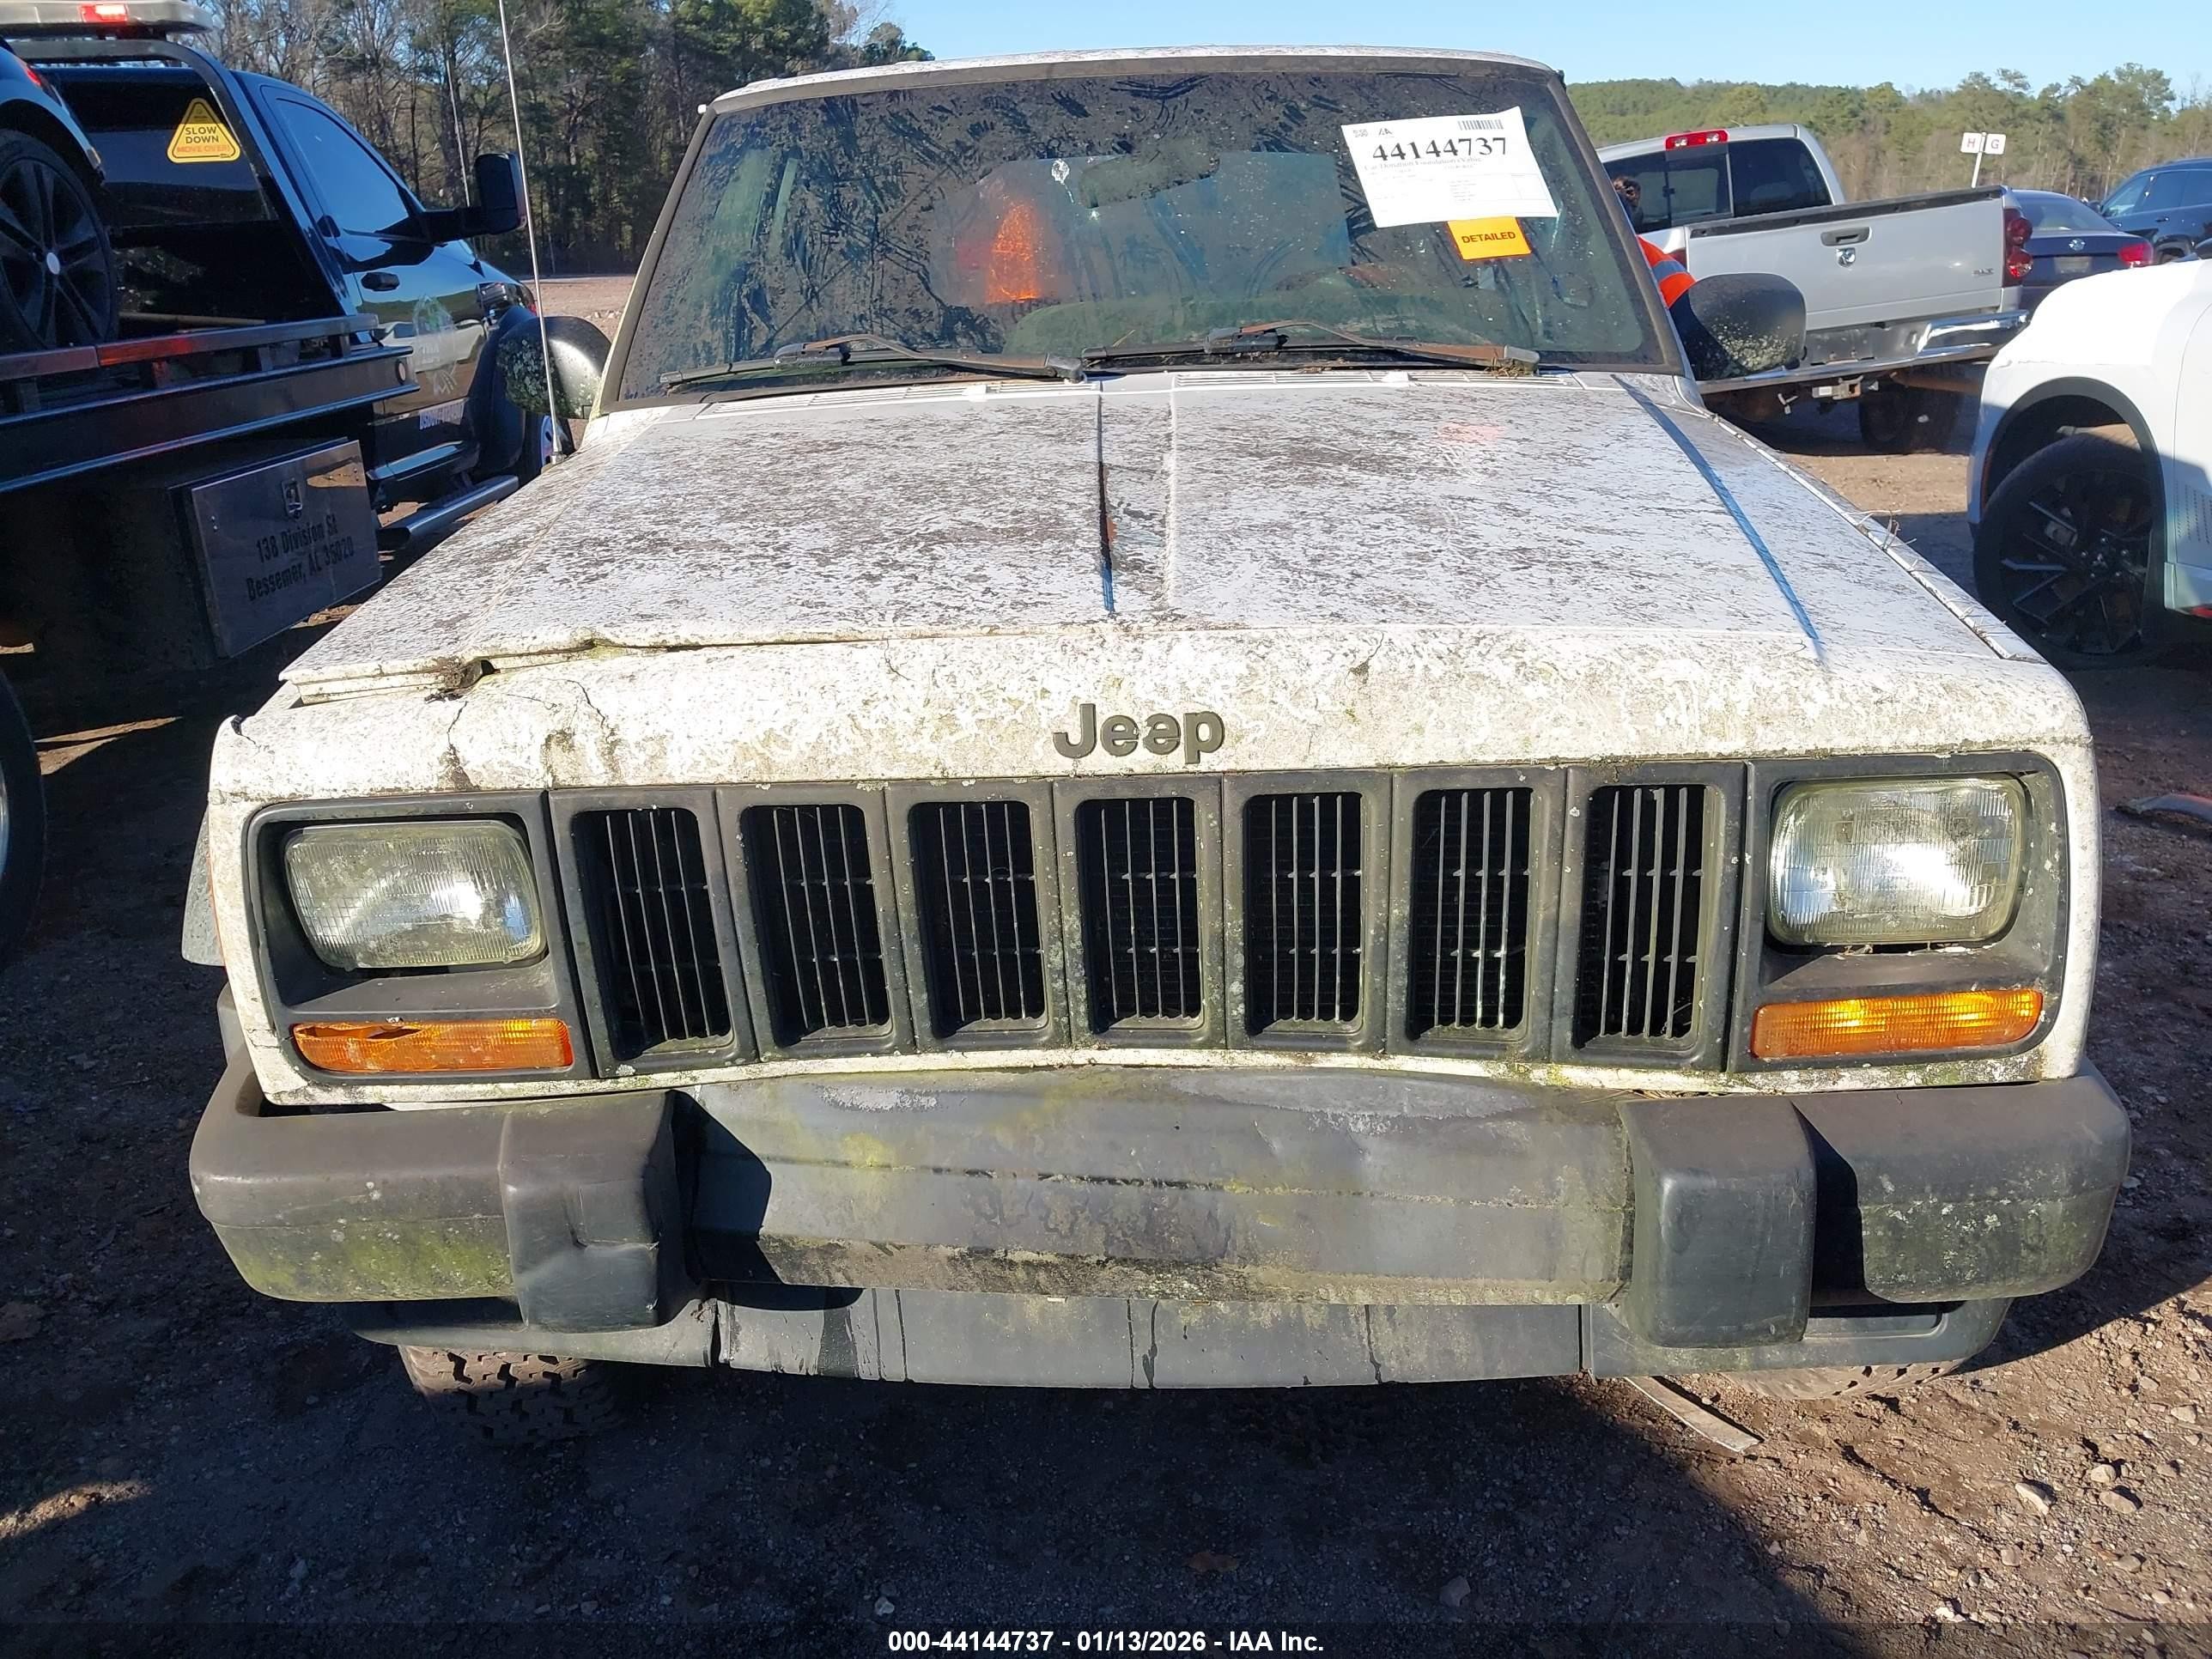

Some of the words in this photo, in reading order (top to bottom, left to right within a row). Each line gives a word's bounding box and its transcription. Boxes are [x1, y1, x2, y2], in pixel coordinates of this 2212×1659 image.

[185, 125, 216, 136] SLOW
[185, 136, 220, 144] DOWN
[1966, 137, 1977, 149] H
[1990, 138, 2001, 149] G
[1372, 137, 1506, 161] 44144737
[1461, 231, 1516, 244] DETAILED
[256, 535, 279, 563] 138
[281, 522, 325, 554] Division
[325, 514, 338, 537] St
[246, 562, 307, 601] Bessemer,
[308, 550, 322, 576] AL
[323, 536, 355, 566] 35020
[1052, 702, 1225, 764] Jeep
